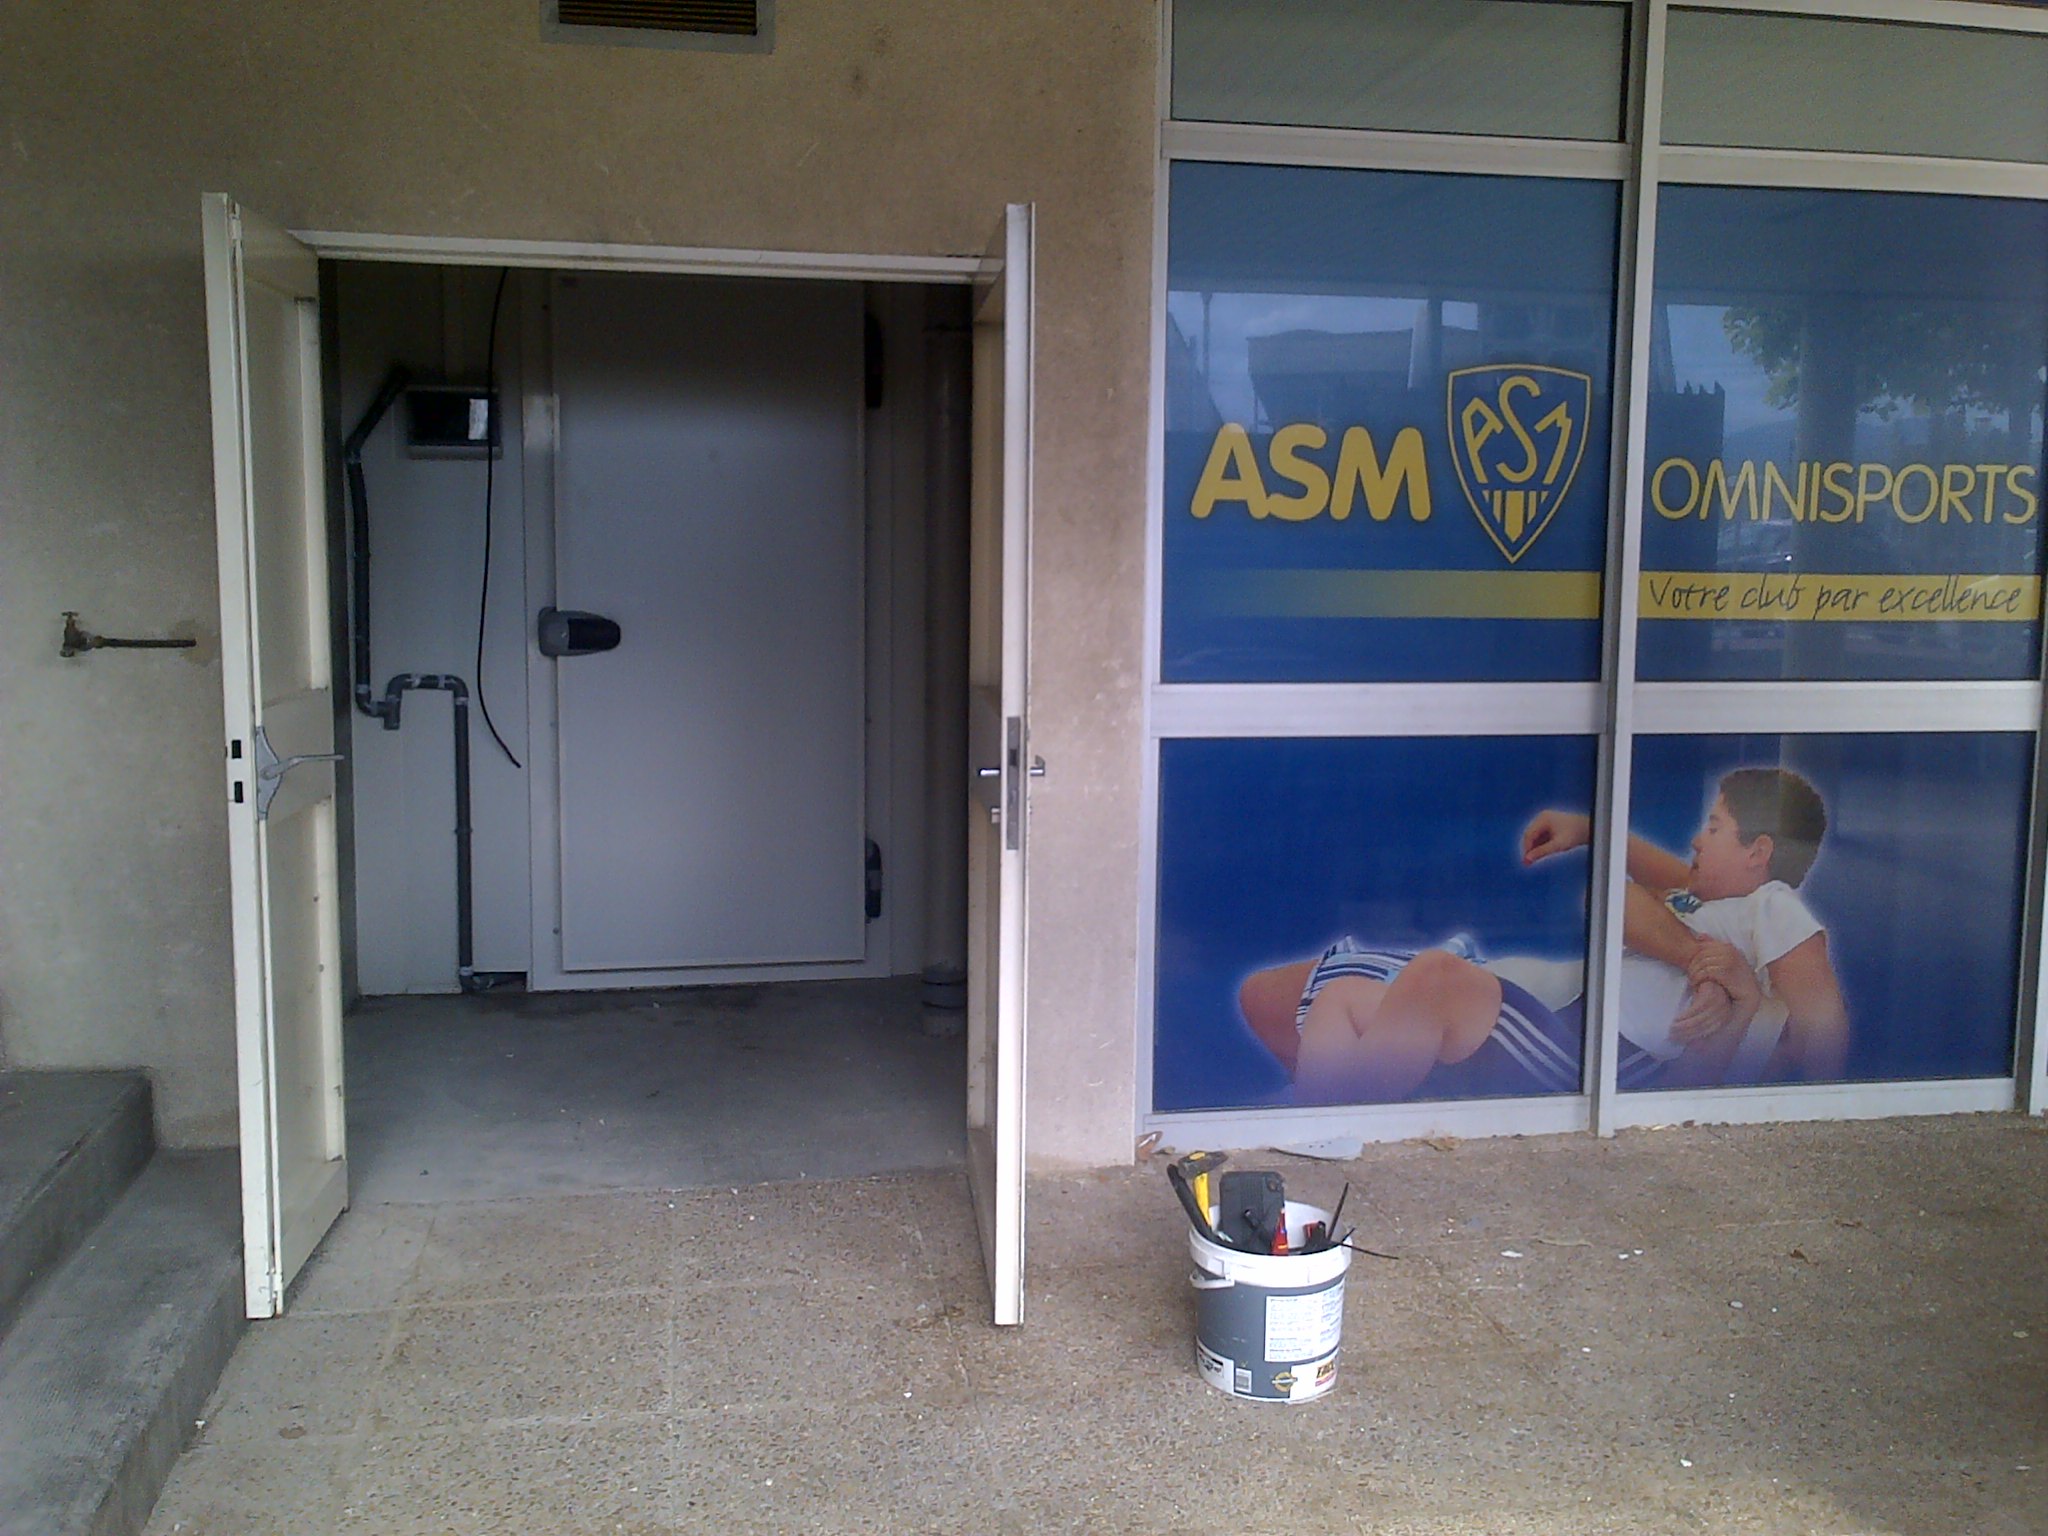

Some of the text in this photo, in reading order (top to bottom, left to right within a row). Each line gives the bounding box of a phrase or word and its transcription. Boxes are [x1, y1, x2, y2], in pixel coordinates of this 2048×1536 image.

[1191, 422, 2038, 525] ASM OMNISPORTS
[1649, 574, 2021, 620] Votre club par excellence
